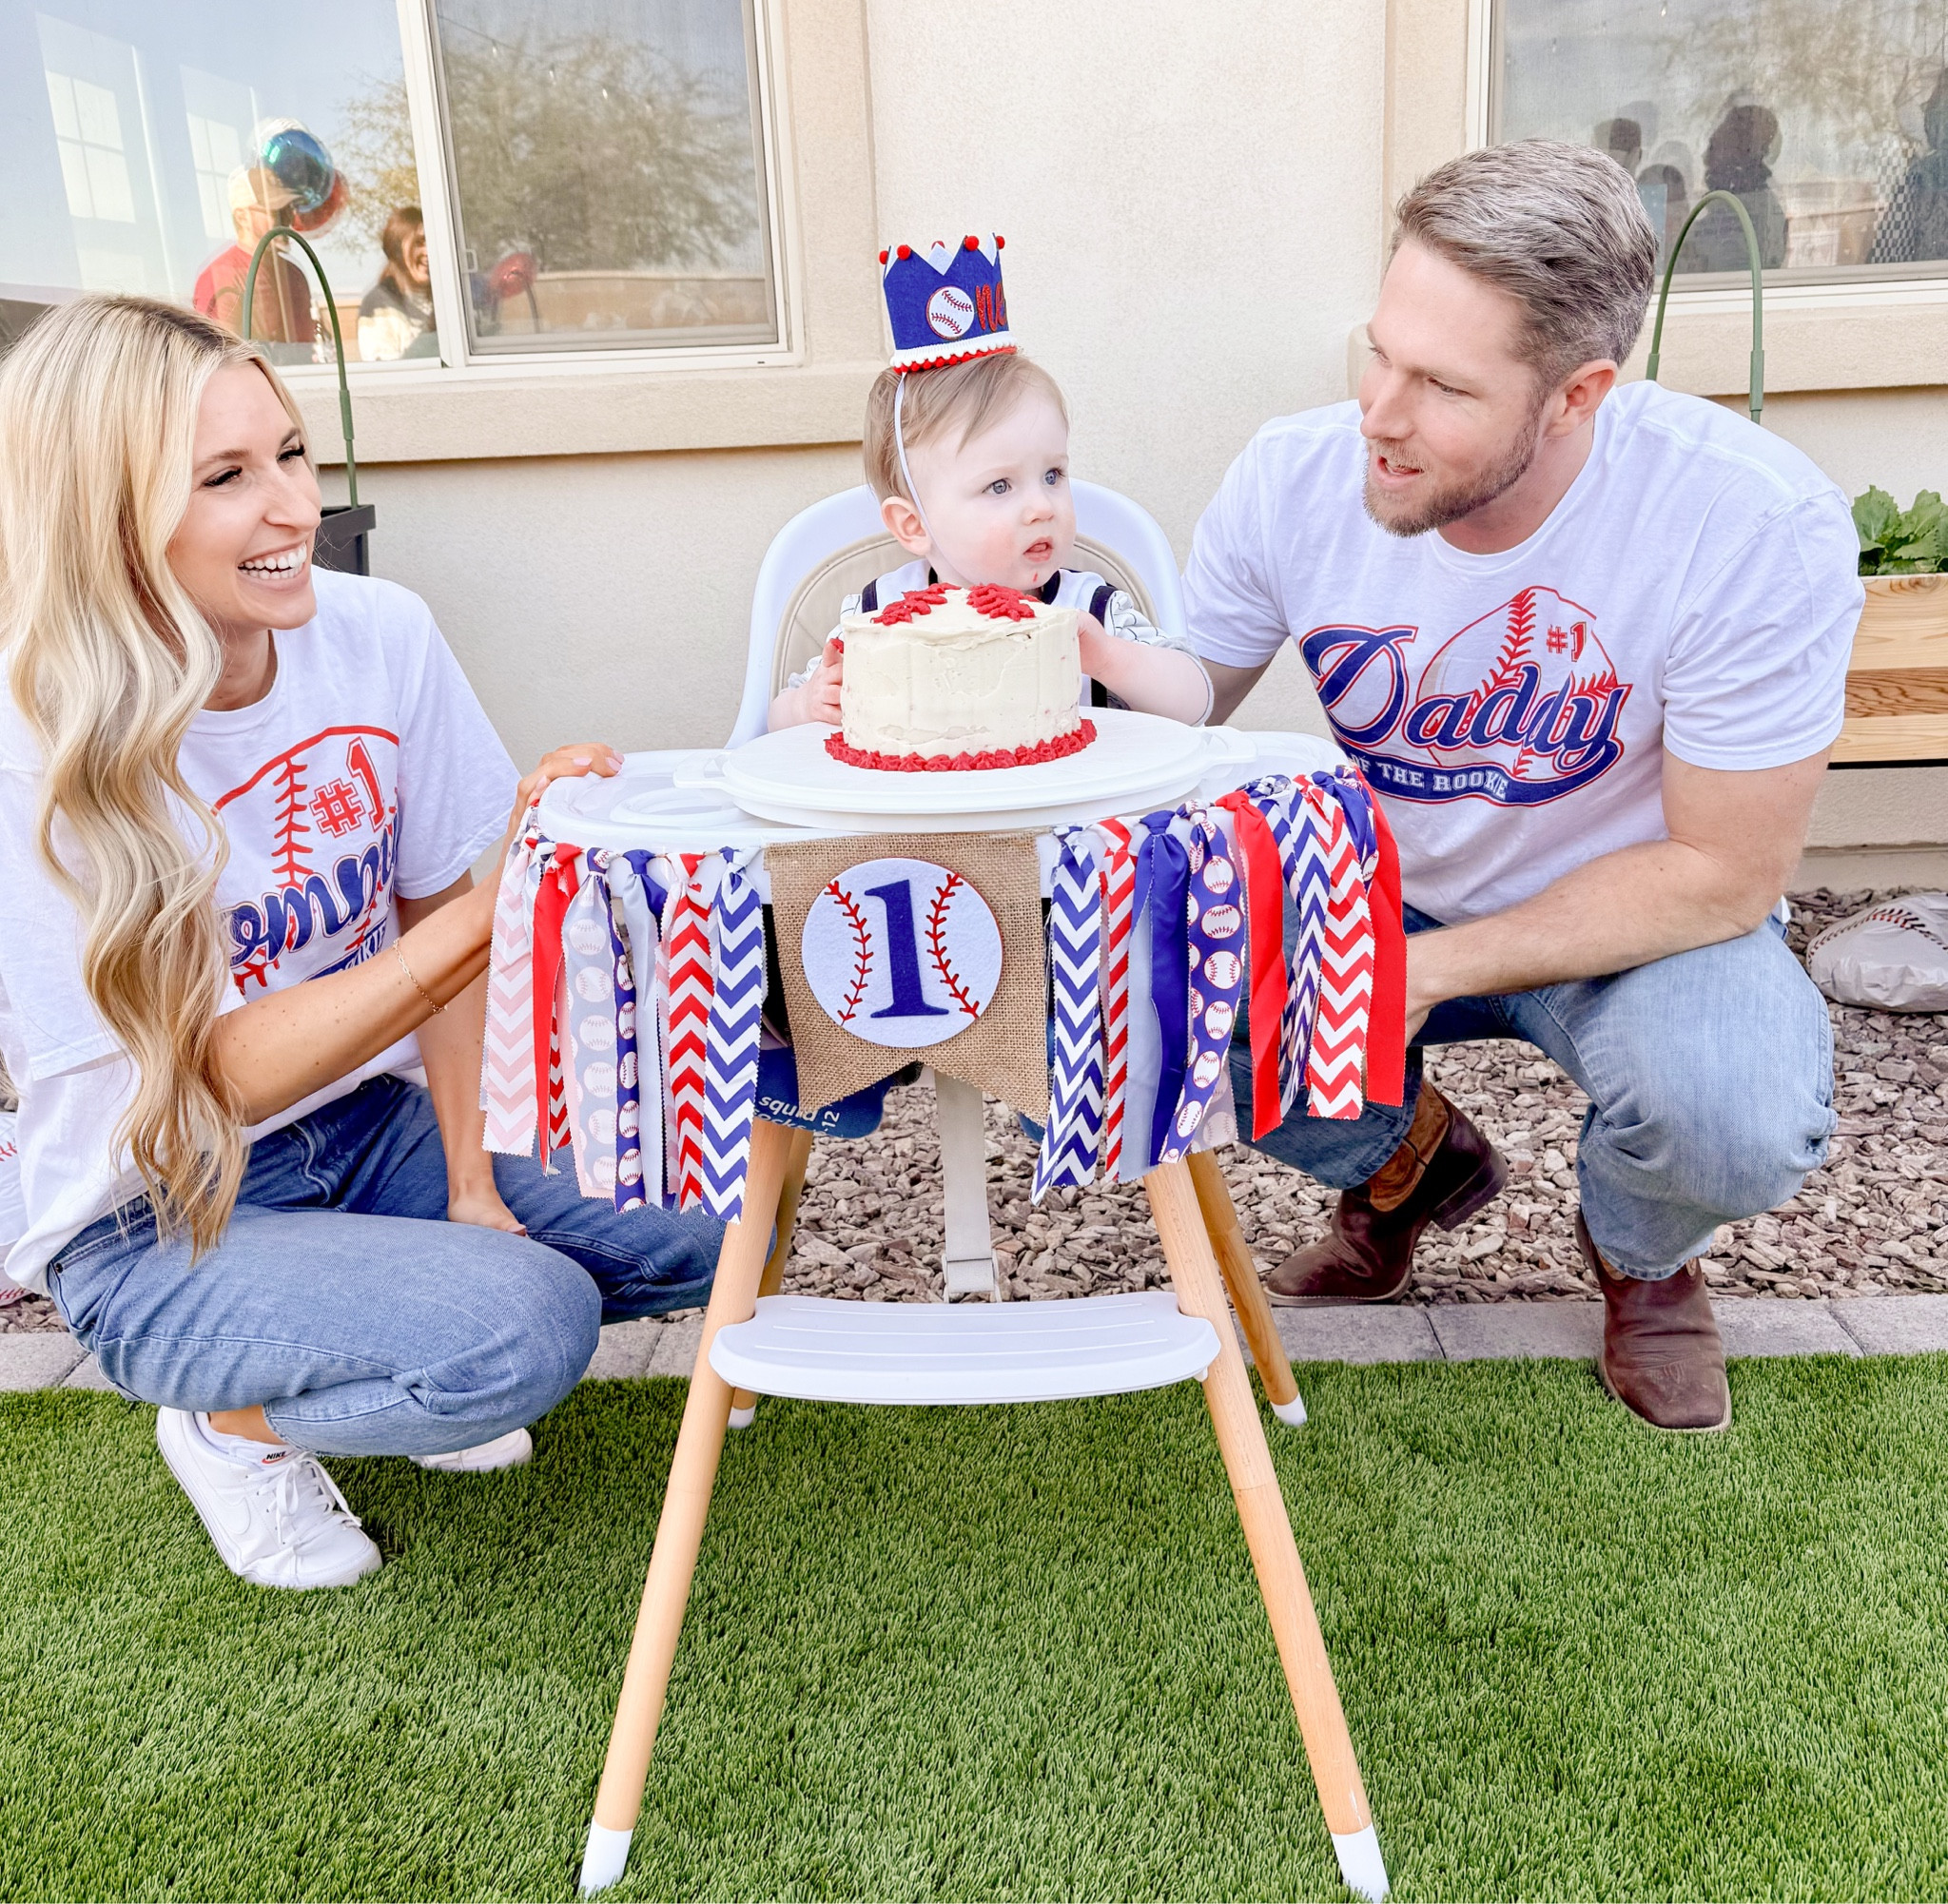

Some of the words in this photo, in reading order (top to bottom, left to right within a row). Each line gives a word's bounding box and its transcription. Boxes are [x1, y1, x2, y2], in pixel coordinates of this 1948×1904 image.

[1546, 621, 1587, 663] #1
[1298, 623, 1633, 773] Daddy
[309, 736, 385, 838] #1
[1375, 761, 1425, 788] THE
[1432, 769, 1509, 801] ROOKIE
[864, 879, 949, 1019] 1
[266, 1450, 286, 1460] NIKE
